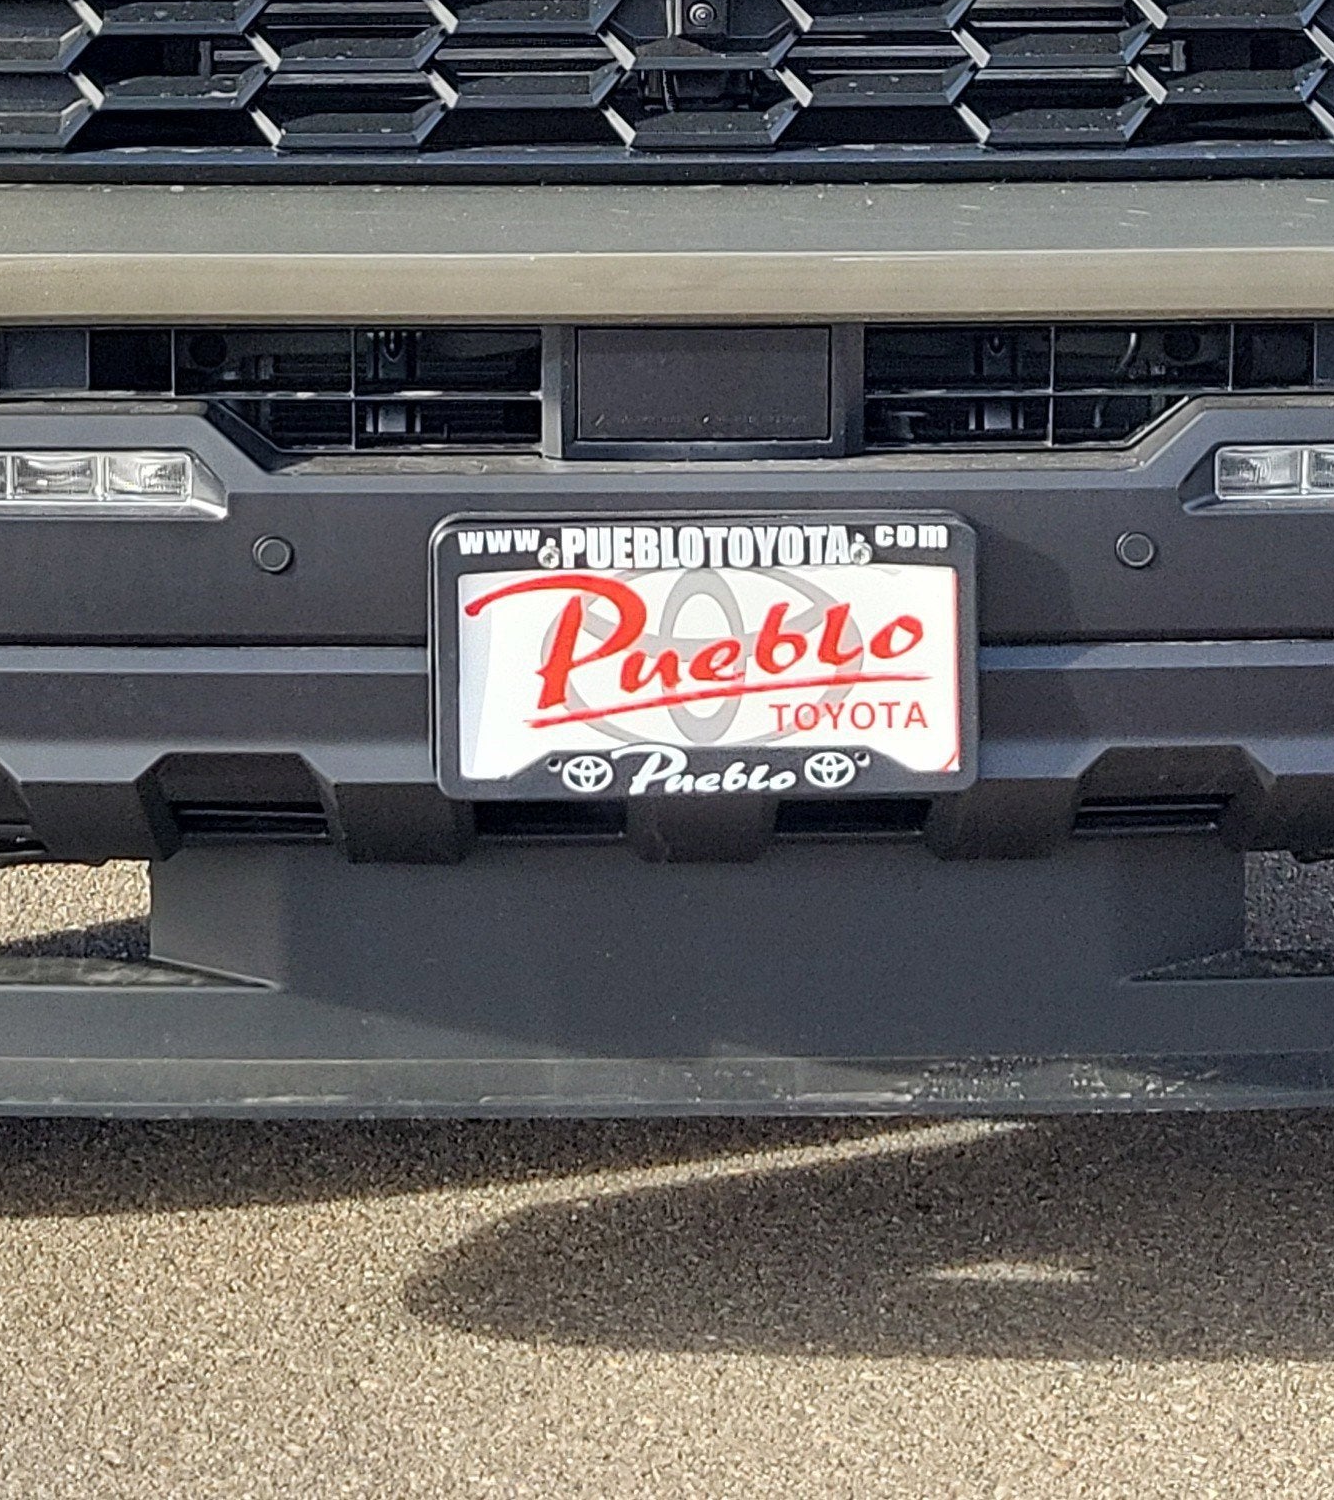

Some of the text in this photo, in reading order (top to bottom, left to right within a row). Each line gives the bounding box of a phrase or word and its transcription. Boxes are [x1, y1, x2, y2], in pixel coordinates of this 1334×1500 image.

[464, 574, 924, 710] Pueblo
[770, 701, 929, 732] TOYOTA
[611, 743, 797, 795] Pueblo
